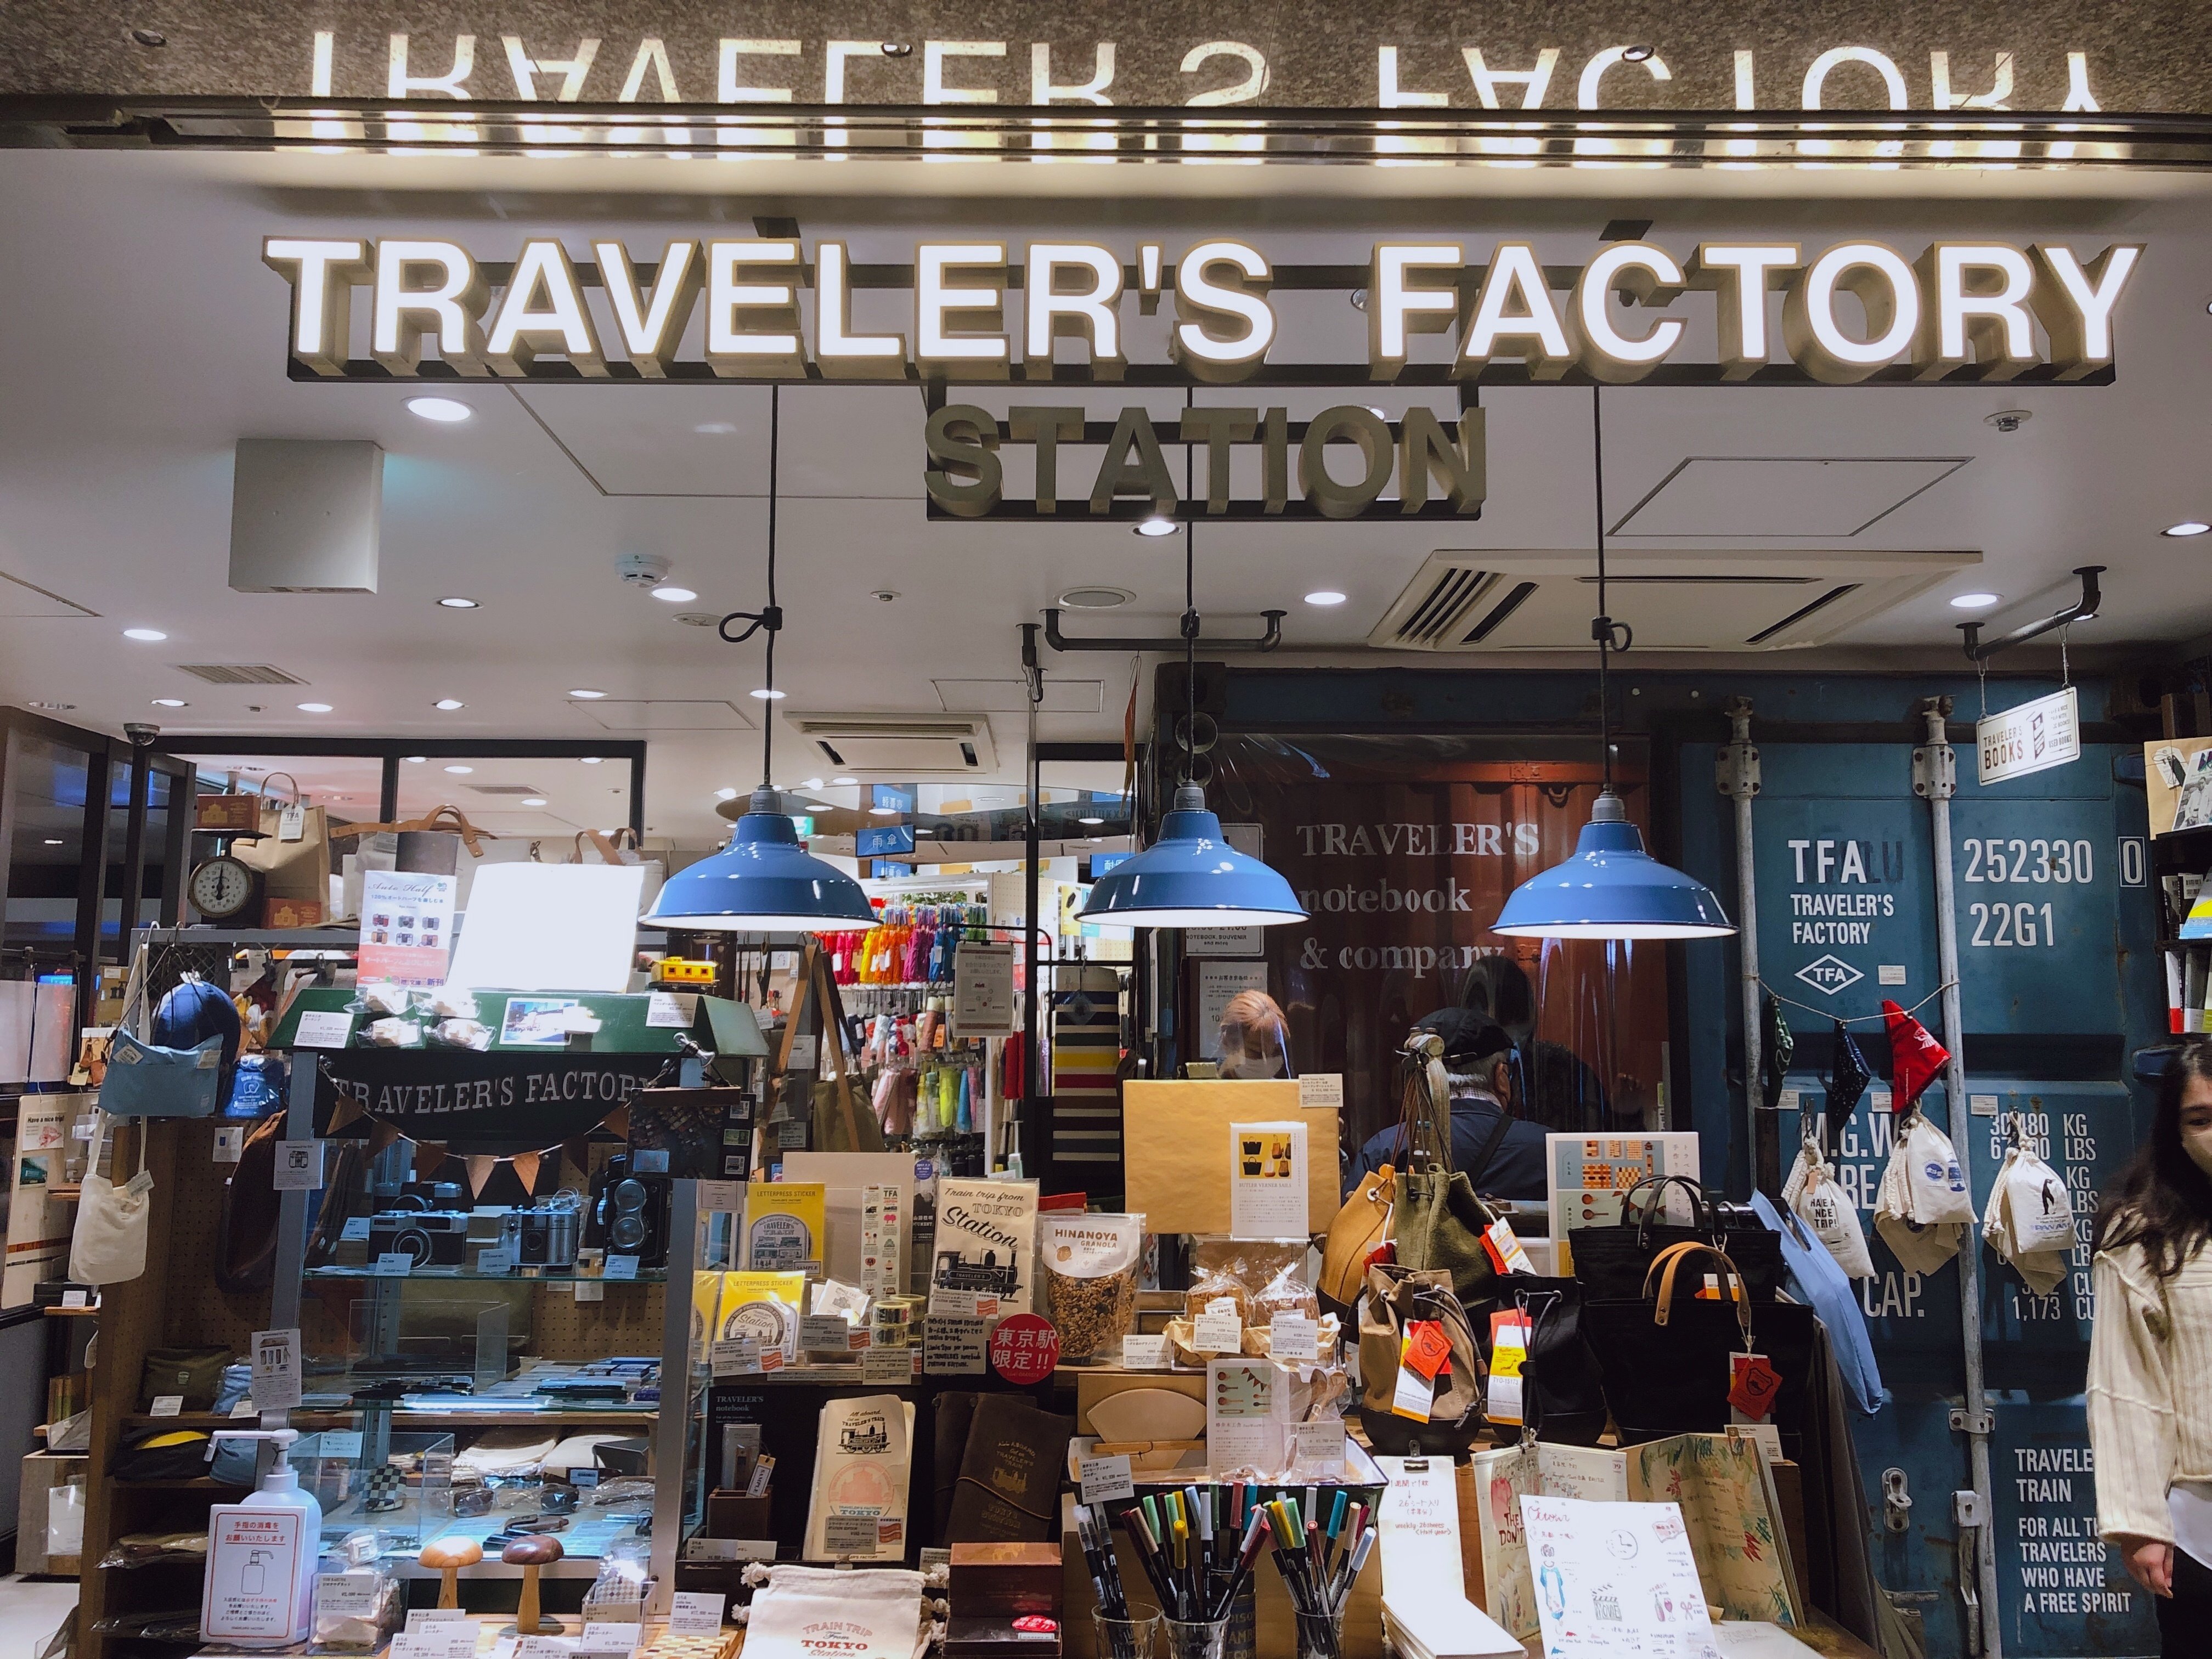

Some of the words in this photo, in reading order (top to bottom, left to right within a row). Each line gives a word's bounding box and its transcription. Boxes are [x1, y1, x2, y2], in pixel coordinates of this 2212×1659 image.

[263, 237, 1277, 372] TRAVELER'S
[1373, 239, 2145, 373] FACTORY
[924, 403, 1486, 517] STATION
[1984, 726, 2023, 747] TRAVELERS
[2058, 735, 2072, 745] BOOKS
[1984, 740, 2023, 770] BOOKS
[872, 834, 896, 848] 雨傘
[1296, 822, 1539, 856] TRAVELER'S
[1788, 840, 1867, 883] TFA
[1963, 838, 2093, 883] 252330
[2123, 840, 2142, 884] 0
[368, 883, 398, 891] Auto
[403, 884, 434, 897] Half
[1299, 878, 1472, 913] notebook
[1790, 894, 1894, 916] TRAVELER'S
[1792, 922, 1871, 944] FACTORY
[1970, 903, 2054, 946] 22G1
[1300, 937, 1328, 969] &
[1813, 968, 1847, 982] TFA
[330, 1076, 514, 1114] TRAVELER'S
[1990, 1113, 2050, 1136] 30480
[2063, 1114, 2087, 1137] KG
[2065, 1138, 2096, 1161] LBS
[1673, 1144, 1681, 1215] 手作りの具たち
[2066, 1166, 2090, 1189] KG
[944, 1188, 974, 1198] Train
[976, 1190, 996, 1200] trip
[996, 1192, 1025, 1202] from
[1810, 1199, 1828, 1207] HAE
[2068, 1190, 2099, 1213] LBS
[972, 1203, 1024, 1217] TOKYO
[940, 1206, 1019, 1251] Station
[1055, 1228, 1118, 1242] HINANOYA
[2074, 1218, 2093, 1242] KG
[2072, 1244, 2091, 1266] LB
[1863, 1271, 1925, 1317] CAP.
[2074, 1272, 2094, 1296] CU
[2013, 1296, 2061, 1321] 1,173
[2076, 1297, 2096, 1321] CU
[738, 1314, 774, 1328] Station
[994, 1327, 1058, 1351] 東京駅
[992, 1350, 1049, 1369] 限定!!
[1493, 1376, 1519, 1386] TYO-15173
[842, 1417, 871, 1427] TRAVELER'S
[996, 1451, 1034, 1467] TRAVELER'S
[1005, 1460, 1023, 1469] TRAIN
[2014, 1448, 2094, 1472] TRAVELE
[753, 1469, 766, 1493] SAMPLE
[2016, 1479, 2072, 1502] TRAIN
[234, 1521, 279, 1530] 手指の消毒を
[1395, 1522, 1416, 1531] weekly
[1499, 1526, 1524, 1546] DON'T
[2018, 1517, 2047, 1537] FOR
[2052, 1517, 2080, 1537] ALL
[225, 1534, 285, 1543] お願いいたします
[2019, 1542, 2107, 1562] TRAVELERS
[2021, 1567, 2059, 1588] WHO
[2064, 1567, 2106, 1588] HAVE
[1595, 1601, 1621, 1620] MOVIE
[2024, 1593, 2036, 1613] A
[2039, 1593, 2078, 1613] FREE
[2081, 1593, 2131, 1613] SPIRIT
[803, 1622, 843, 1634] TRAIN
[845, 1622, 873, 1638] TRIP
[822, 1631, 850, 1640] From
[801, 1640, 868, 1650] TOKYO
[808, 1649, 856, 1657] Station
